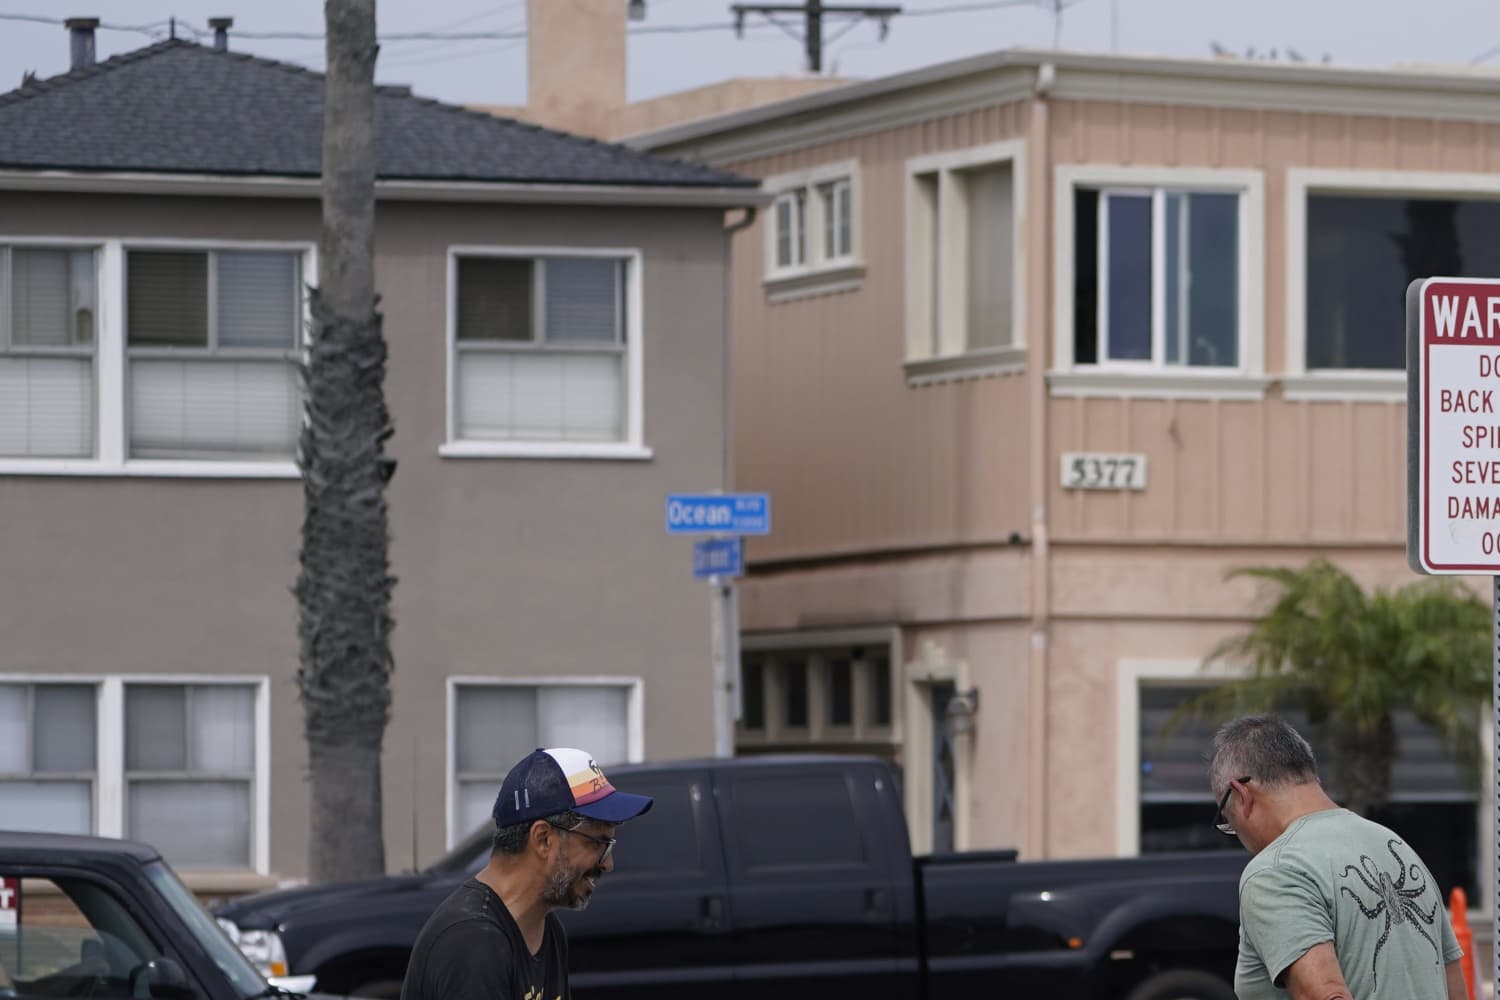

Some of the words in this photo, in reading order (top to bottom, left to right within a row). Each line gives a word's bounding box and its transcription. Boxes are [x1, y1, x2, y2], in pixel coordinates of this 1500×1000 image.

[1440, 389, 1494, 414] BACK
[1071, 457, 1137, 487] 5377
[669, 499, 731, 526] Ocean
